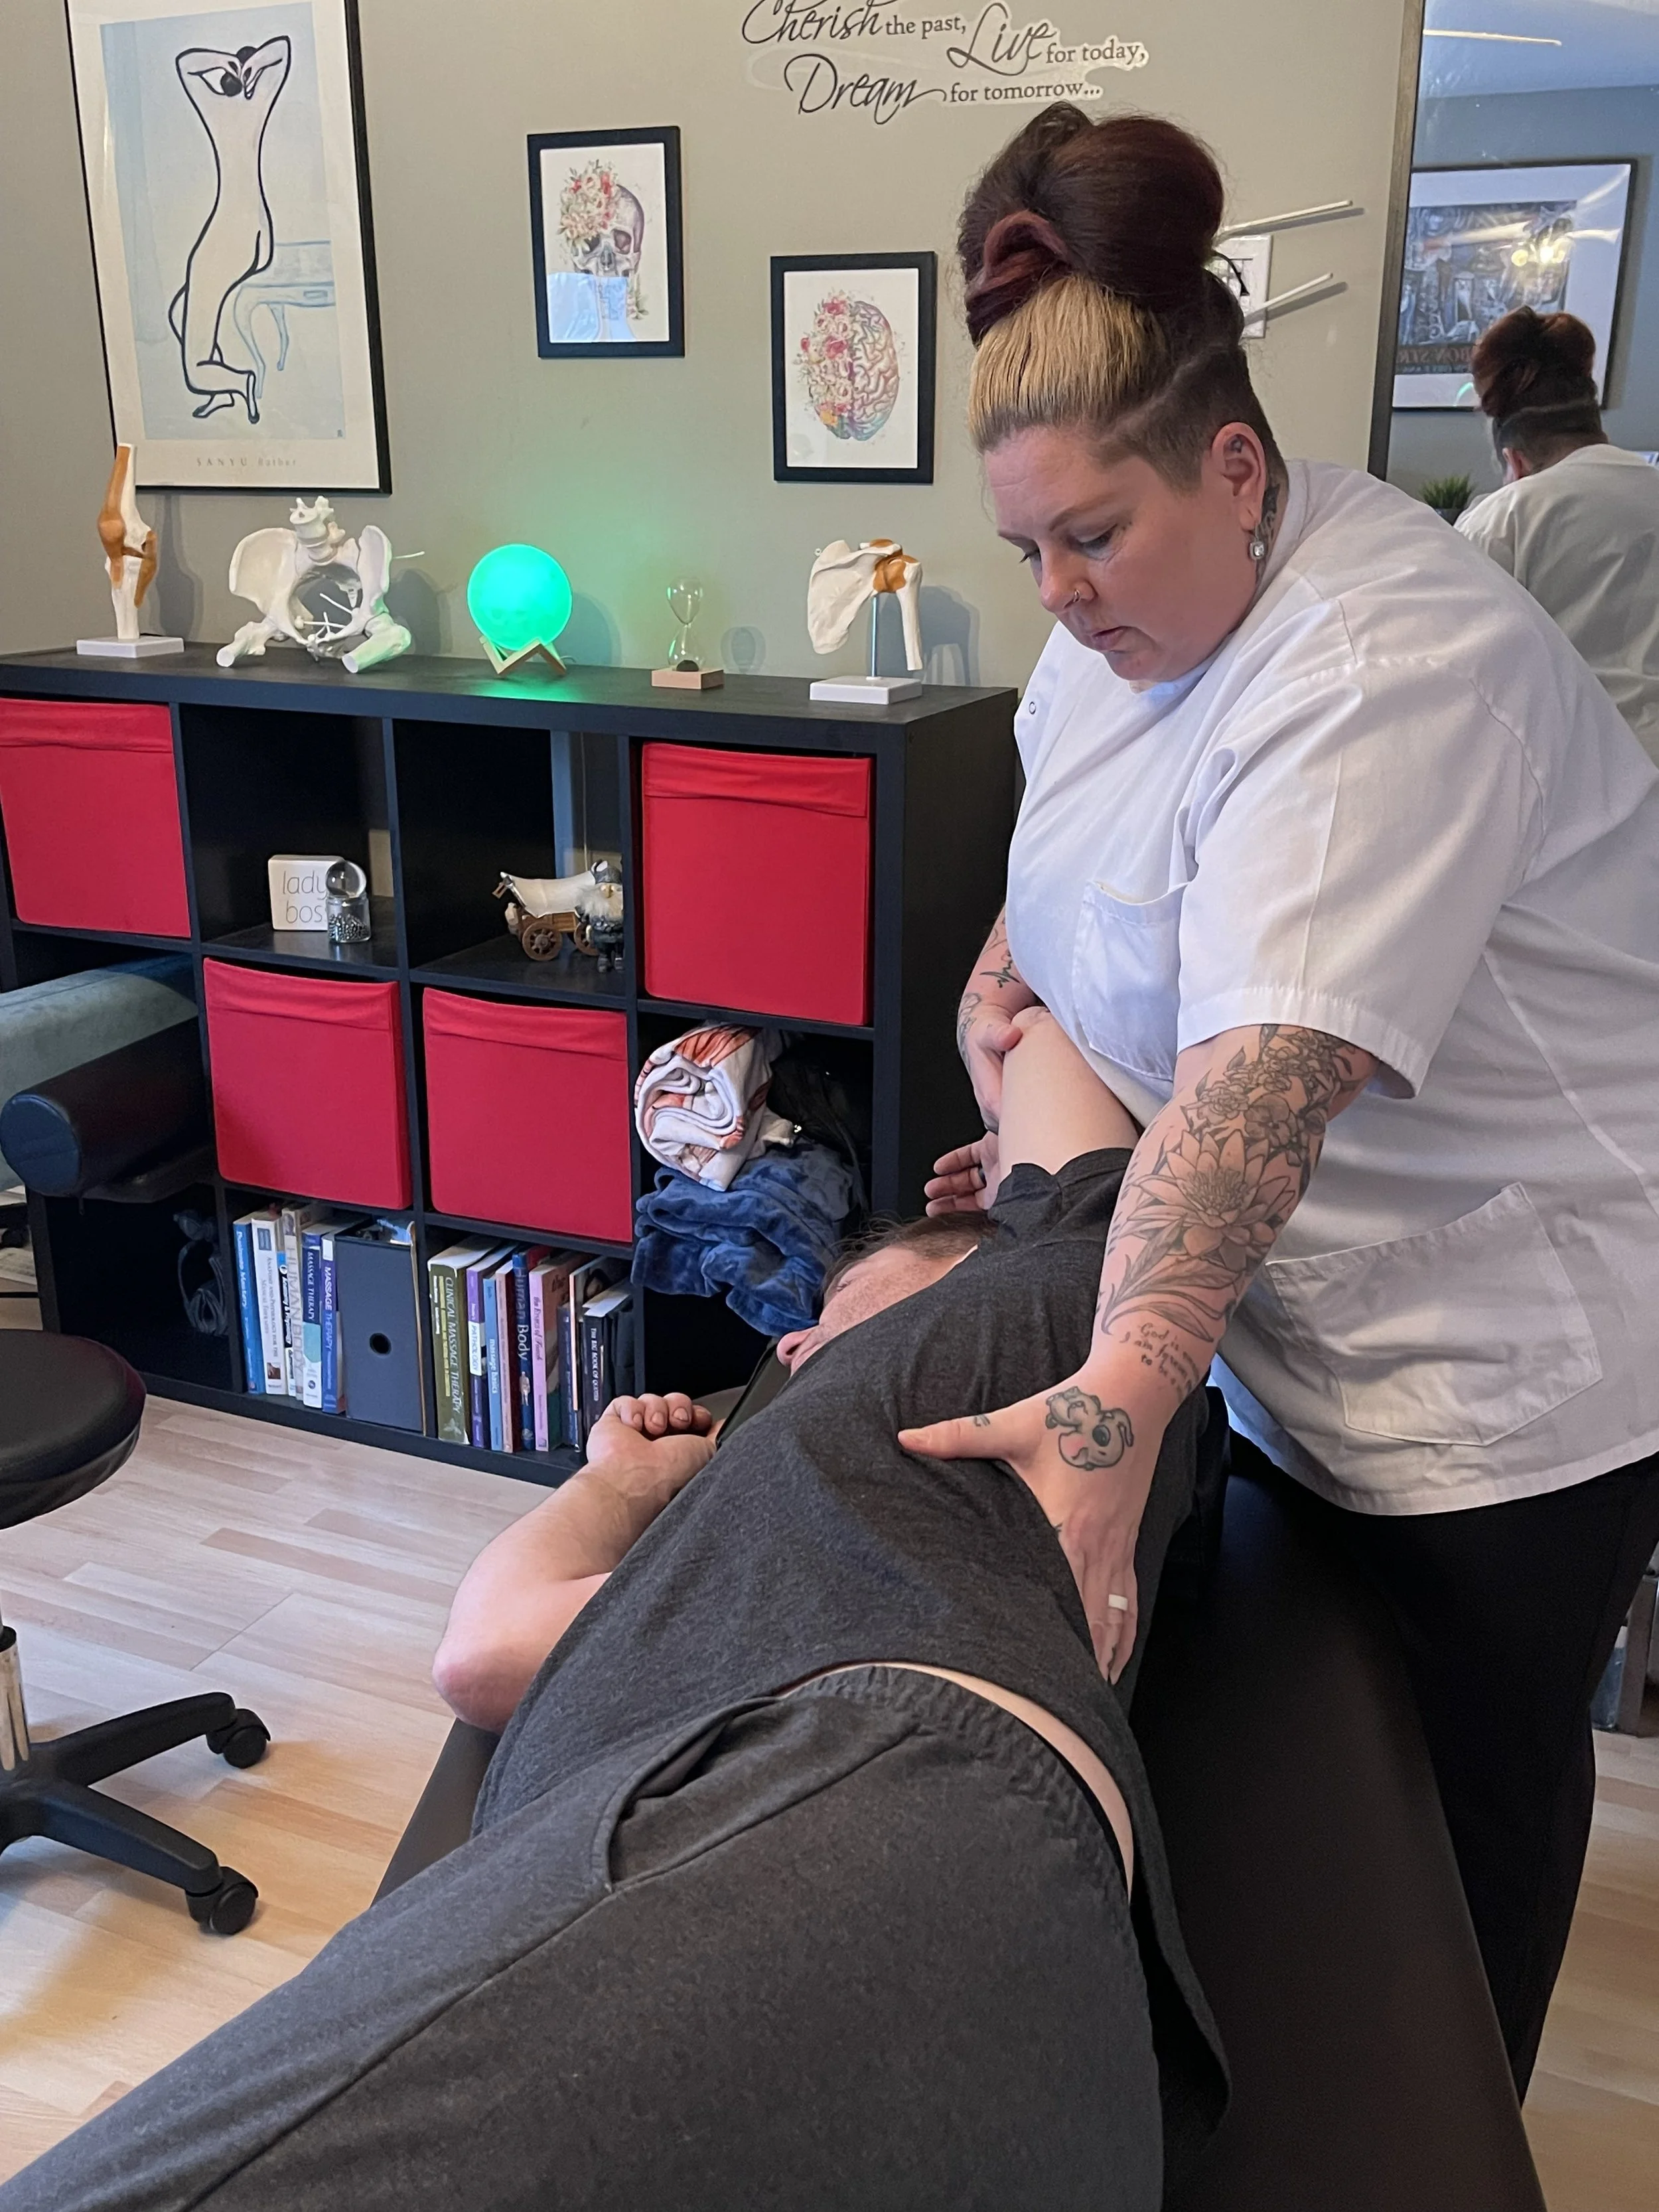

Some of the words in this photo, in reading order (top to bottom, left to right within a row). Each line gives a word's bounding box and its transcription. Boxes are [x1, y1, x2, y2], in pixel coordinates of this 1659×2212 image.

[742, 0, 883, 44] Cherish
[885, 15, 916, 36] the
[920, 16, 968, 40] past,
[946, 3, 1056, 77] Live
[1045, 43, 1077, 64] for
[1082, 39, 1147, 69] today,
[784, 53, 948, 125] Dream
[950, 81, 977, 104] for
[983, 78, 1102, 102] tomorrow...
[196, 457, 248, 467] SANYU
[282, 870, 327, 900] lady
[285, 900, 326, 924] bos
[445, 1277, 457, 1317] CLINICAL
[515, 1267, 526, 1319] Human
[448, 1321, 460, 1367] MASSAGE
[470, 1324, 478, 1371] PATHOLOGY
[518, 1324, 530, 1361] Body
[1141, 1323, 1169, 1339] God
[451, 1369, 463, 1414] THERAPY
